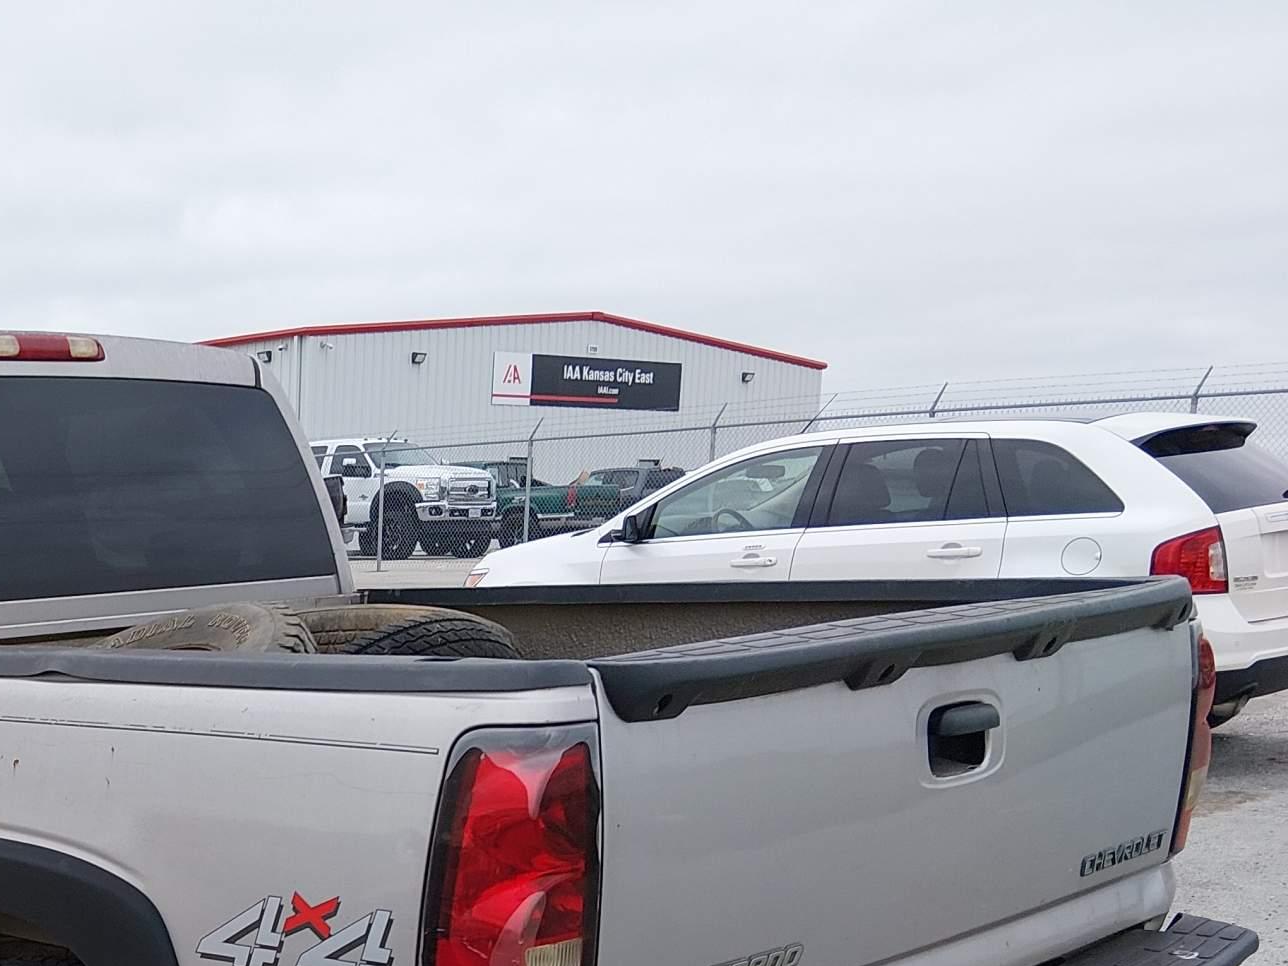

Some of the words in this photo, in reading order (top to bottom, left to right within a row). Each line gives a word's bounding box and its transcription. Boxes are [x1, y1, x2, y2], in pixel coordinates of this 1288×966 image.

[563, 365, 580, 380] IAA
[582, 366, 615, 382] Kansas
[616, 368, 634, 386] City
[634, 369, 654, 384] East
[1079, 829, 1168, 877] CHEVROLET
